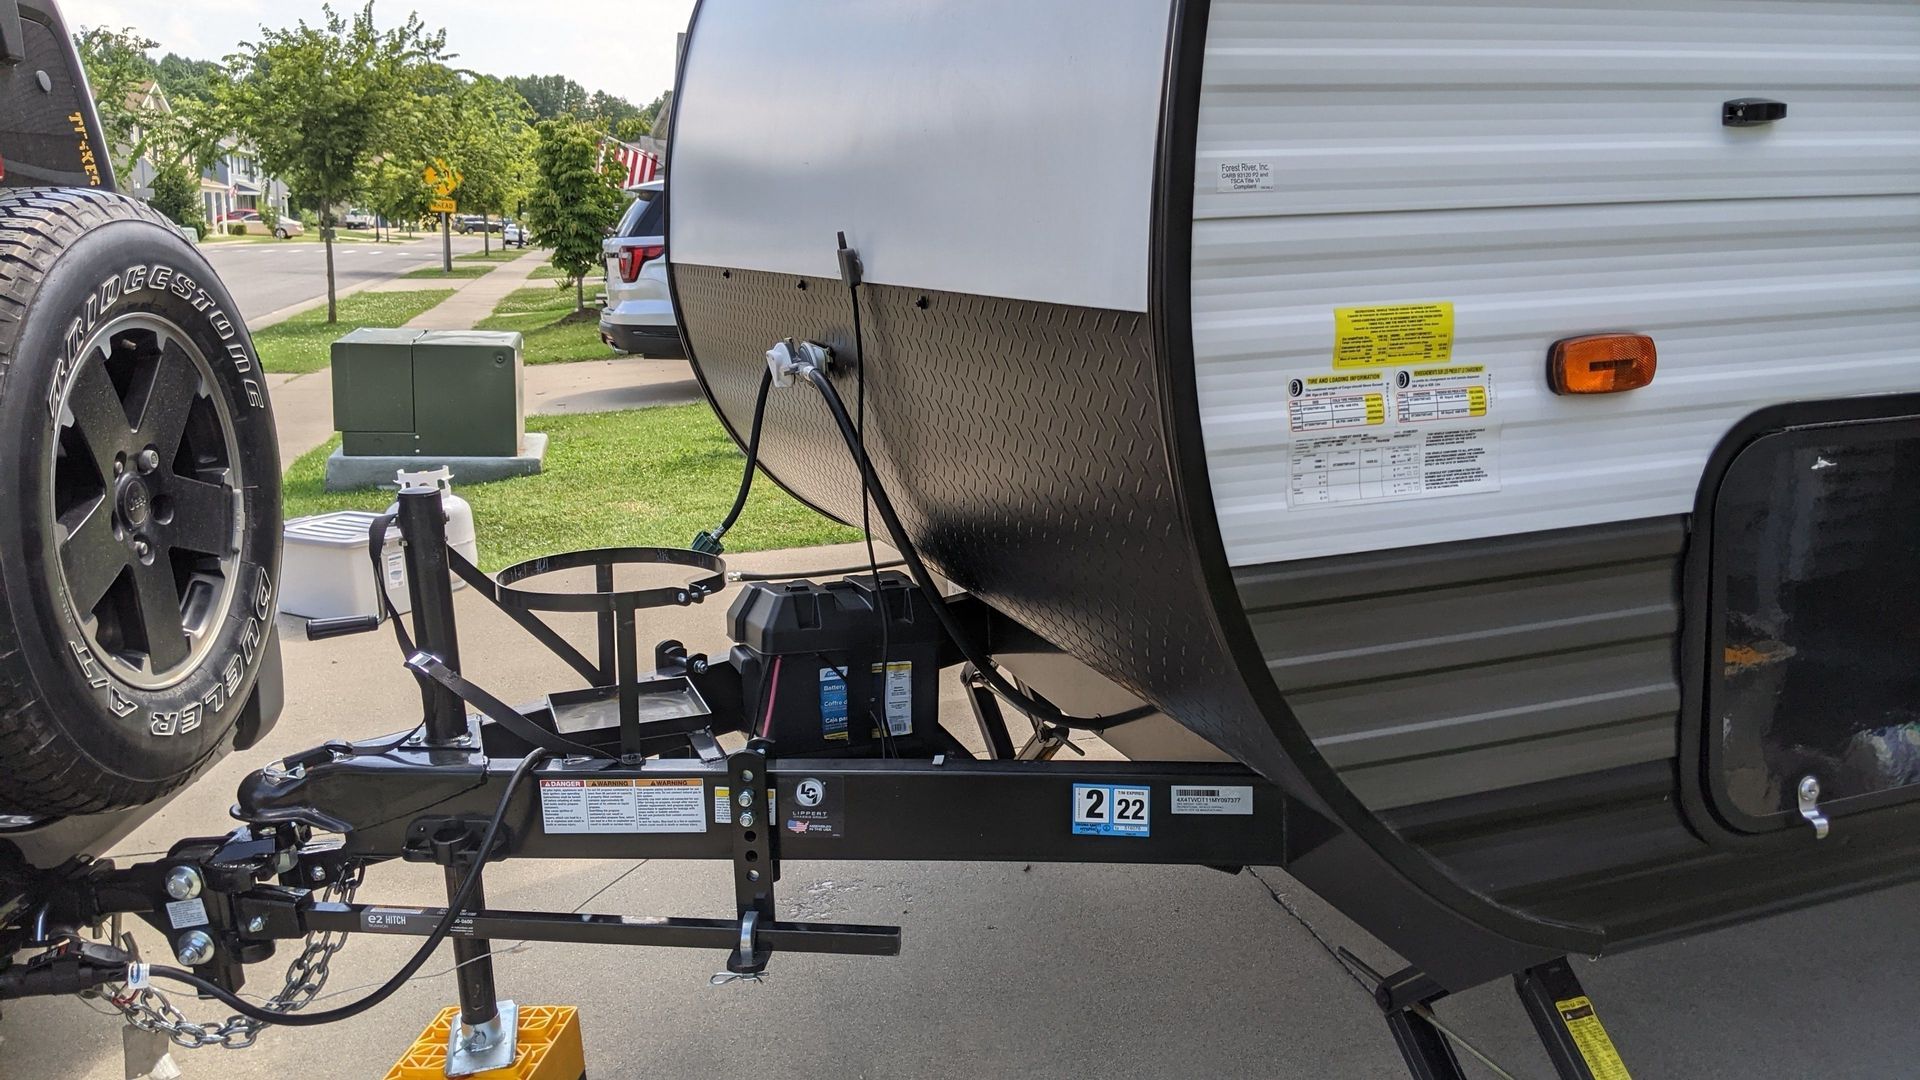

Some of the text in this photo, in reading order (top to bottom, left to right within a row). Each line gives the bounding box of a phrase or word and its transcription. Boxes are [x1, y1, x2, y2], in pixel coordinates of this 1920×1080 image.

[1221, 163, 1240, 171] Forest
[49, 264, 265, 418] BRIDGESTONE
[151, 567, 272, 735] DUELER
[1086, 789, 1104, 819] 2
[1117, 798, 1145, 820] 22
[367, 915, 406, 925] e2 HITCH
